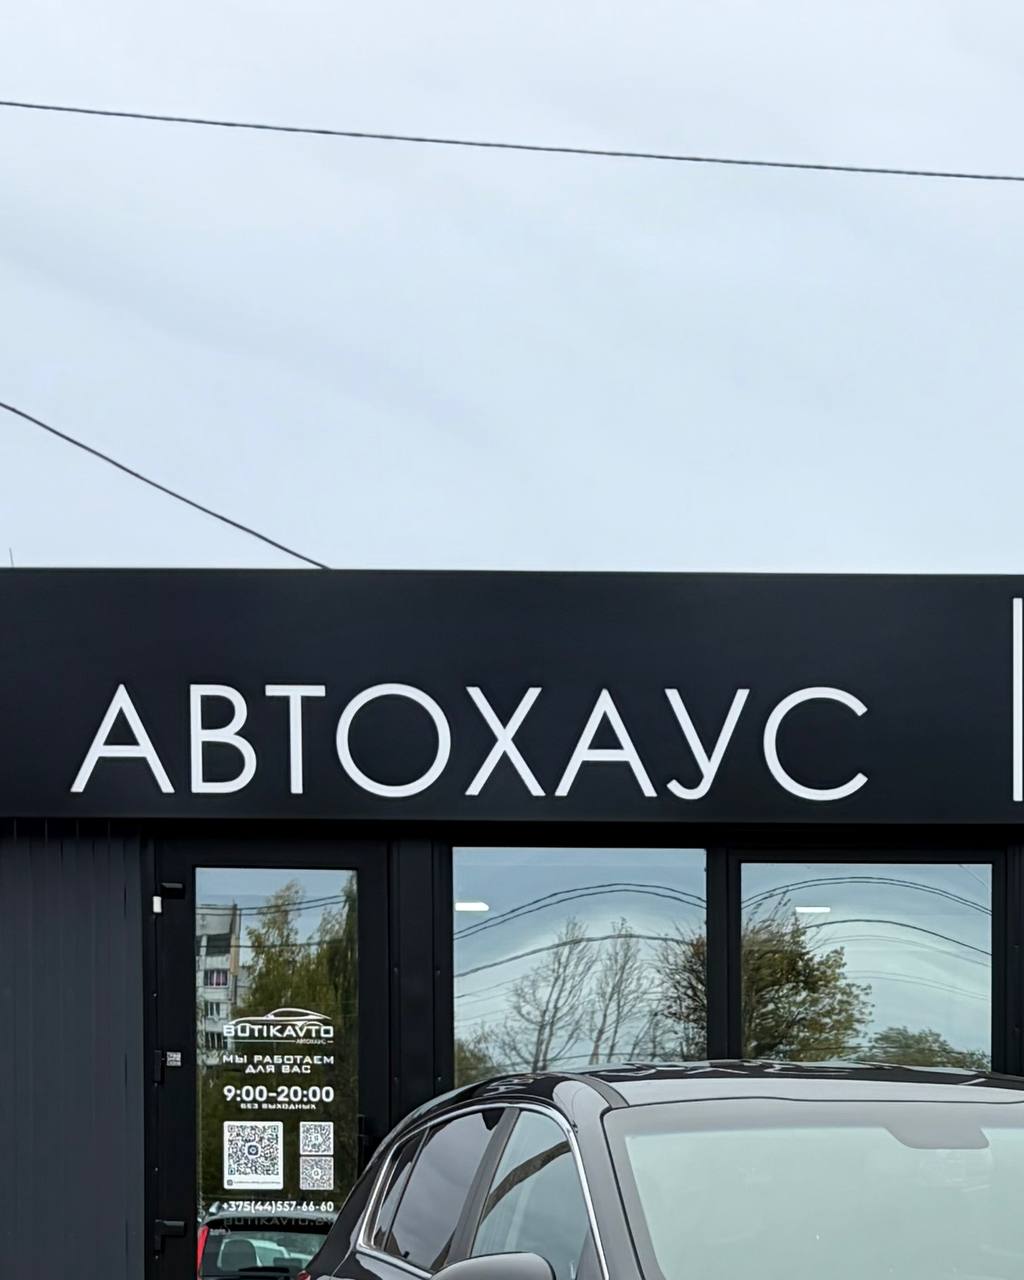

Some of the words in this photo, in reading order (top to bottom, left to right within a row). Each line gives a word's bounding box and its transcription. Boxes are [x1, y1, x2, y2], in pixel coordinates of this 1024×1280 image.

[70, 683, 869, 800] АВТОХАУС
[223, 1024, 334, 1038] BUTIKAVTO
[222, 1055, 248, 1064] МЫ
[253, 1055, 334, 1065] РАБОТАЕМ
[245, 1065, 275, 1074] ДЛЯ
[282, 1065, 311, 1074] ВАС
[223, 1085, 334, 1102] 9:00-20:00
[222, 1201, 334, 1213] +375(44)557-66-60
